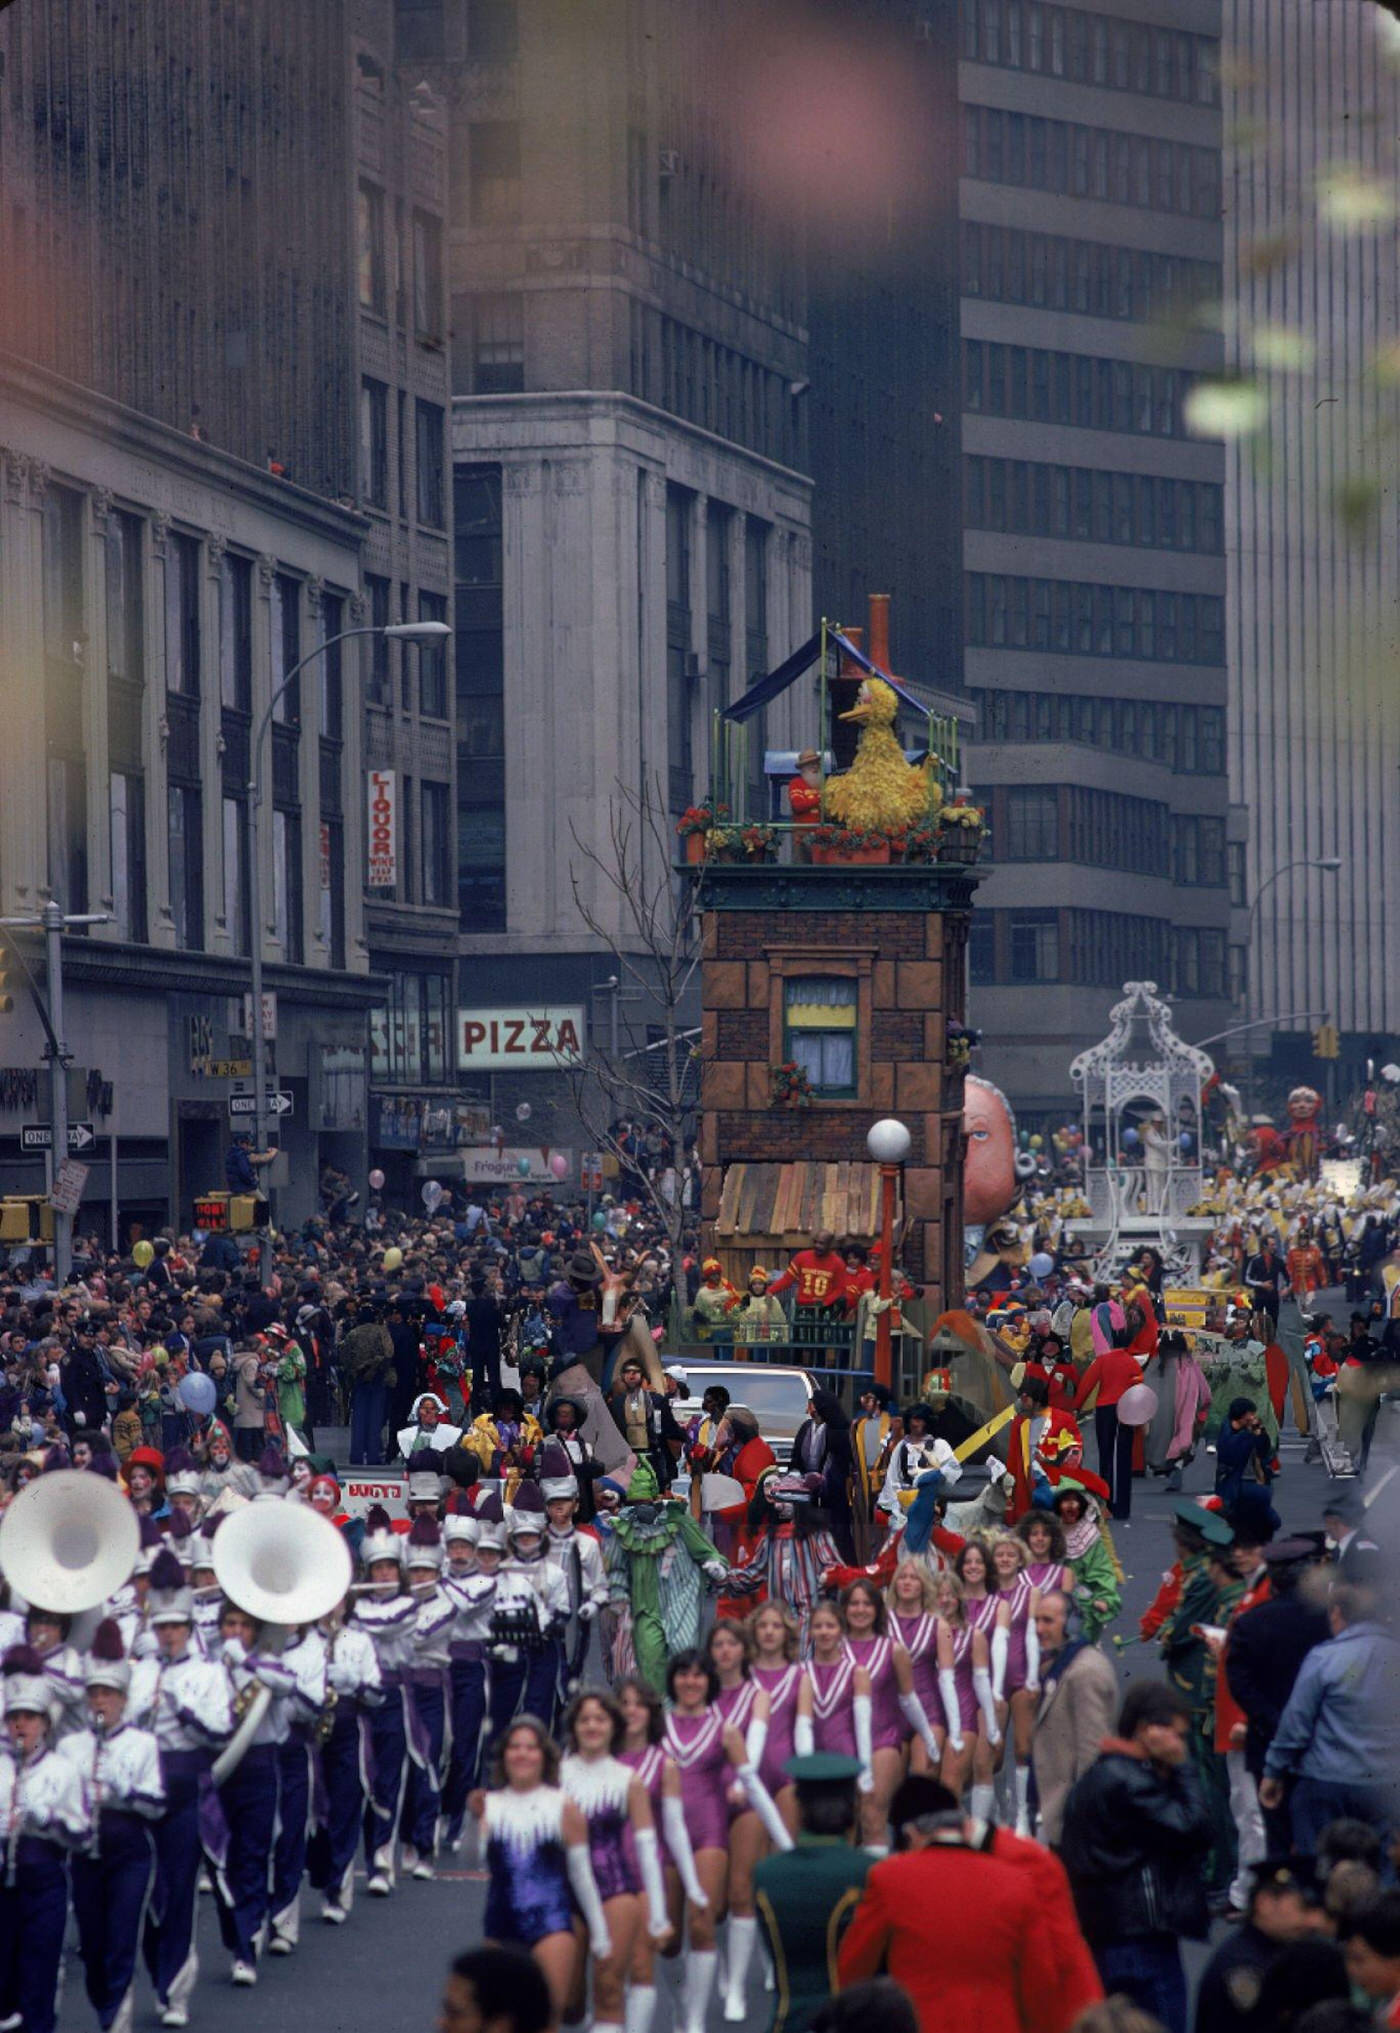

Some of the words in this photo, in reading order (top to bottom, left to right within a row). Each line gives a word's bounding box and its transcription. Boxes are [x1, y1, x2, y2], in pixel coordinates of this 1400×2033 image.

[372, 772, 391, 856] LIQUOR
[368, 856, 395, 867] WINE
[464, 1019, 580, 1054] PIZZA
[211, 1064, 219, 1075] W
[223, 1064, 238, 1075] 36
[27, 1131, 49, 1144] ONE
